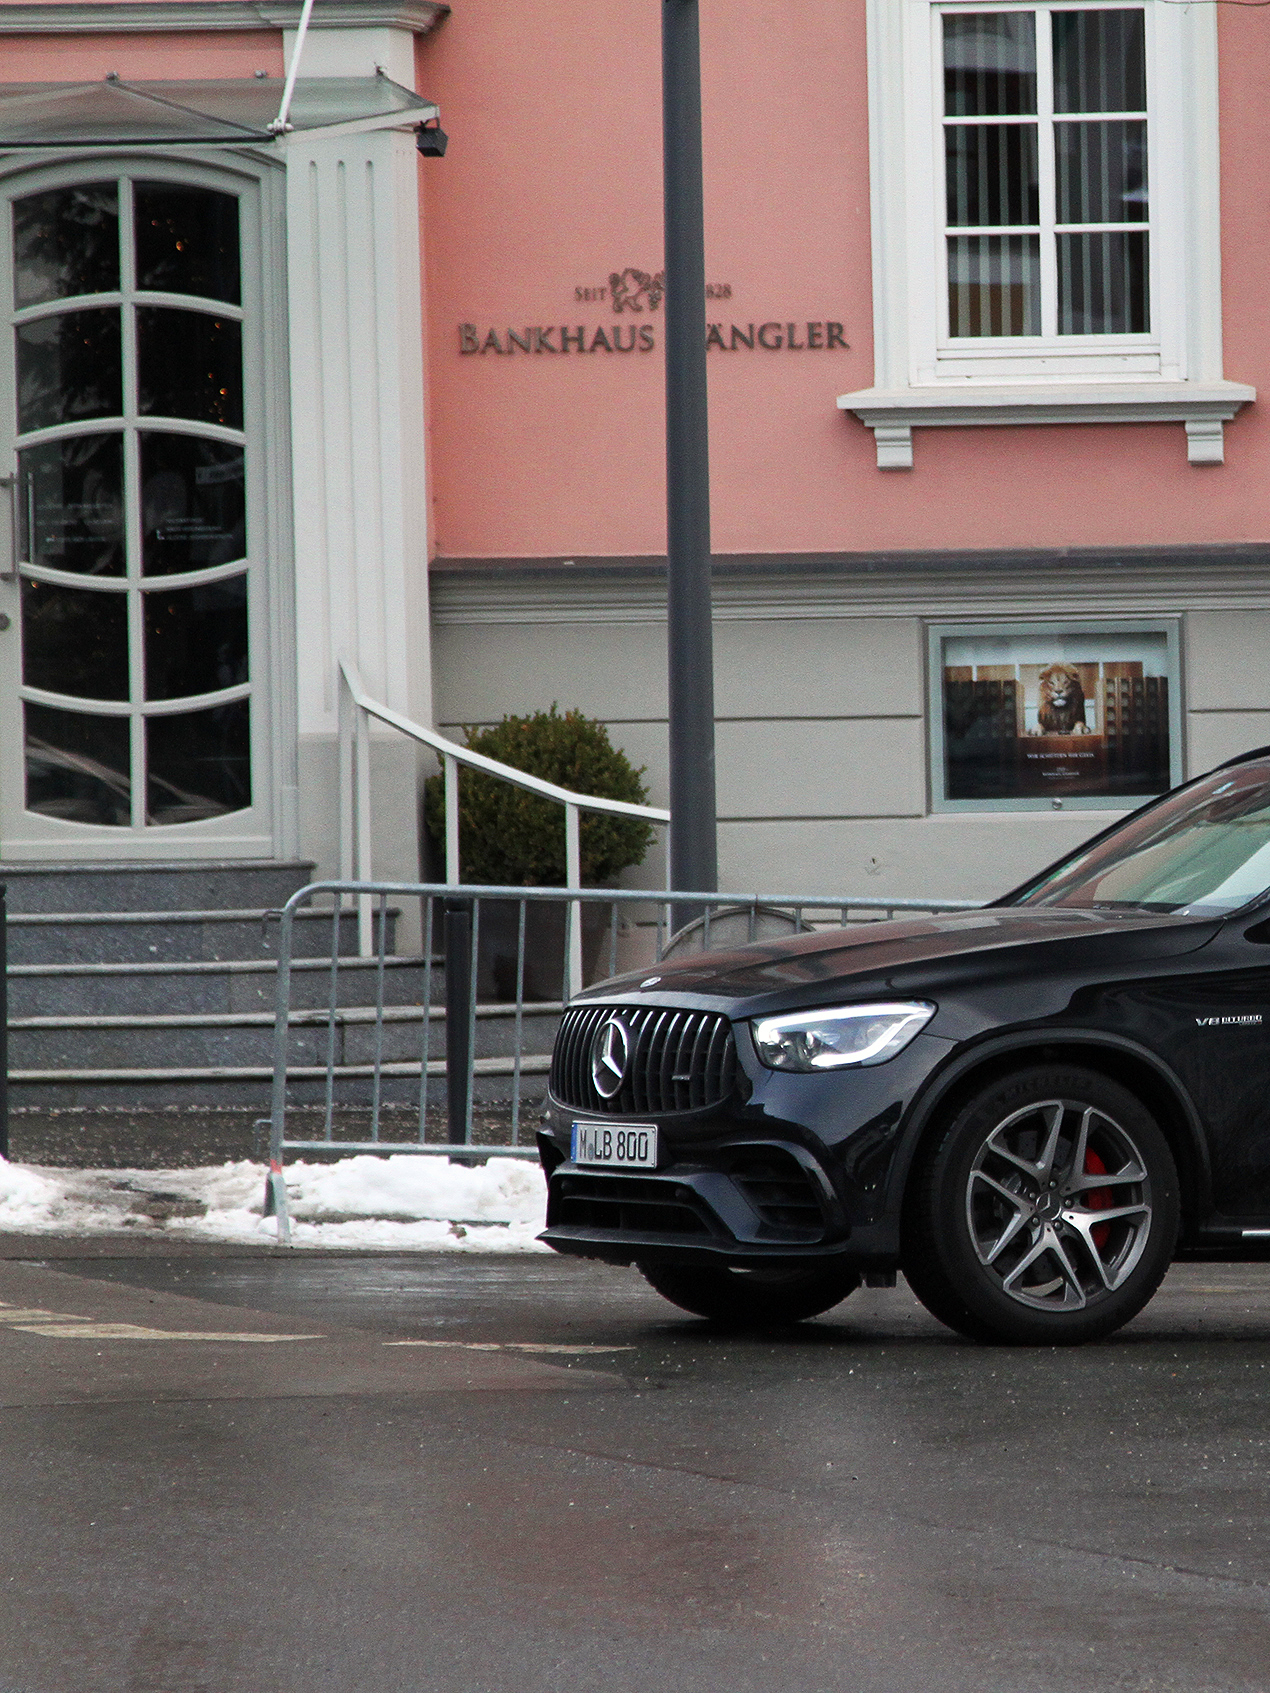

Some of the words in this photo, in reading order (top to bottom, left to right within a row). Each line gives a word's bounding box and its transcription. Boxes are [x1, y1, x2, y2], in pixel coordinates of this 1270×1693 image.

[574, 286, 606, 301] SEIT
[706, 283, 732, 299] 828
[458, 321, 655, 355] BANKHAUS
[706, 321, 851, 352] ÄNGLER
[1195, 1017, 1220, 1026] V8
[594, 1128, 613, 1161] LB
[616, 1130, 649, 1162] 800
